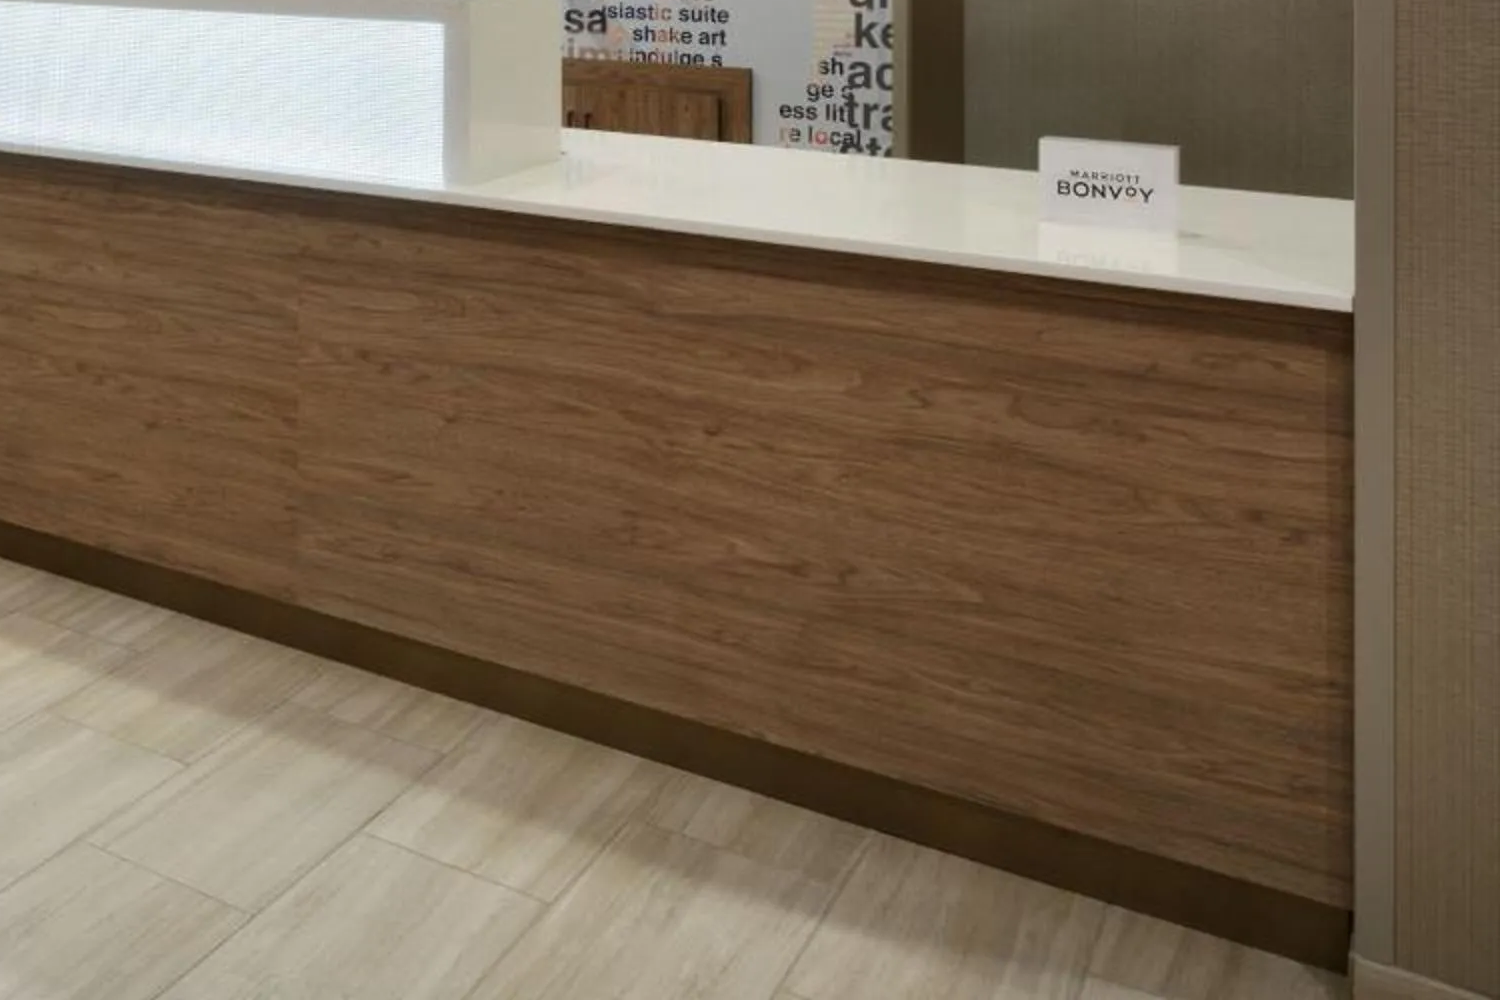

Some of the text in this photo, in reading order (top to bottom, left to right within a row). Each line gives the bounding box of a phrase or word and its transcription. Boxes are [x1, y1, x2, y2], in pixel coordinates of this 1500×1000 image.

[564, 7, 607, 35] sa
[678, 6, 730, 24] suite
[632, 25, 727, 47] shake art
[806, 81, 835, 102] ge
[779, 103, 818, 121] ess
[1070, 169, 1140, 185] MARRIOTT
[1056, 180, 1153, 203] BONVOY
